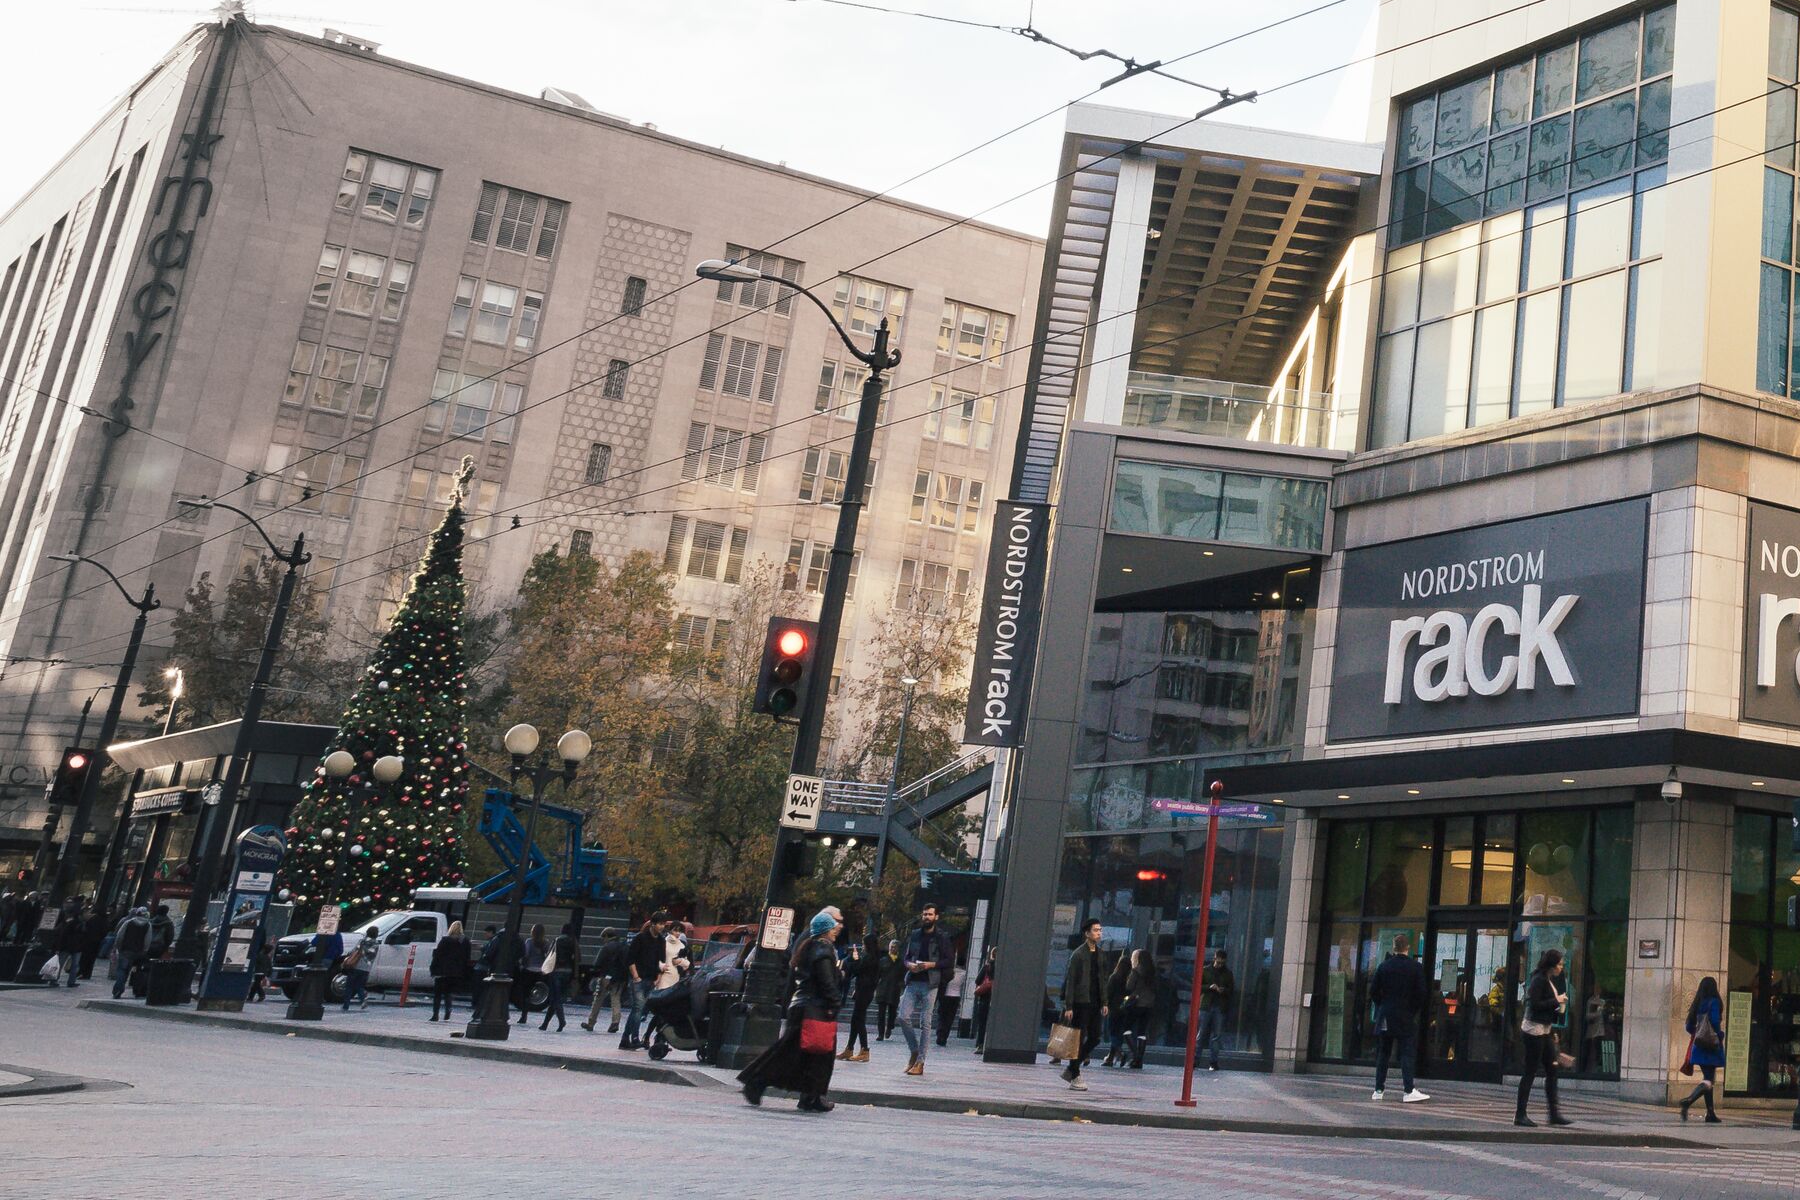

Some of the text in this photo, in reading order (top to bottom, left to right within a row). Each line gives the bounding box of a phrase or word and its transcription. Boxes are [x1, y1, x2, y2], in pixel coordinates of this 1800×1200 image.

[1401, 549, 1544, 600] NORDSTROM
[982, 507, 1033, 737] NORDSTROM rack
[1384, 584, 1580, 704] rack
[793, 779, 819, 794] ONE
[790, 794, 817, 808] WAY
[243, 850, 278, 861] MONORAIL
[770, 919, 789, 927] STOPS
[1602, 1040, 1615, 1054] HO
